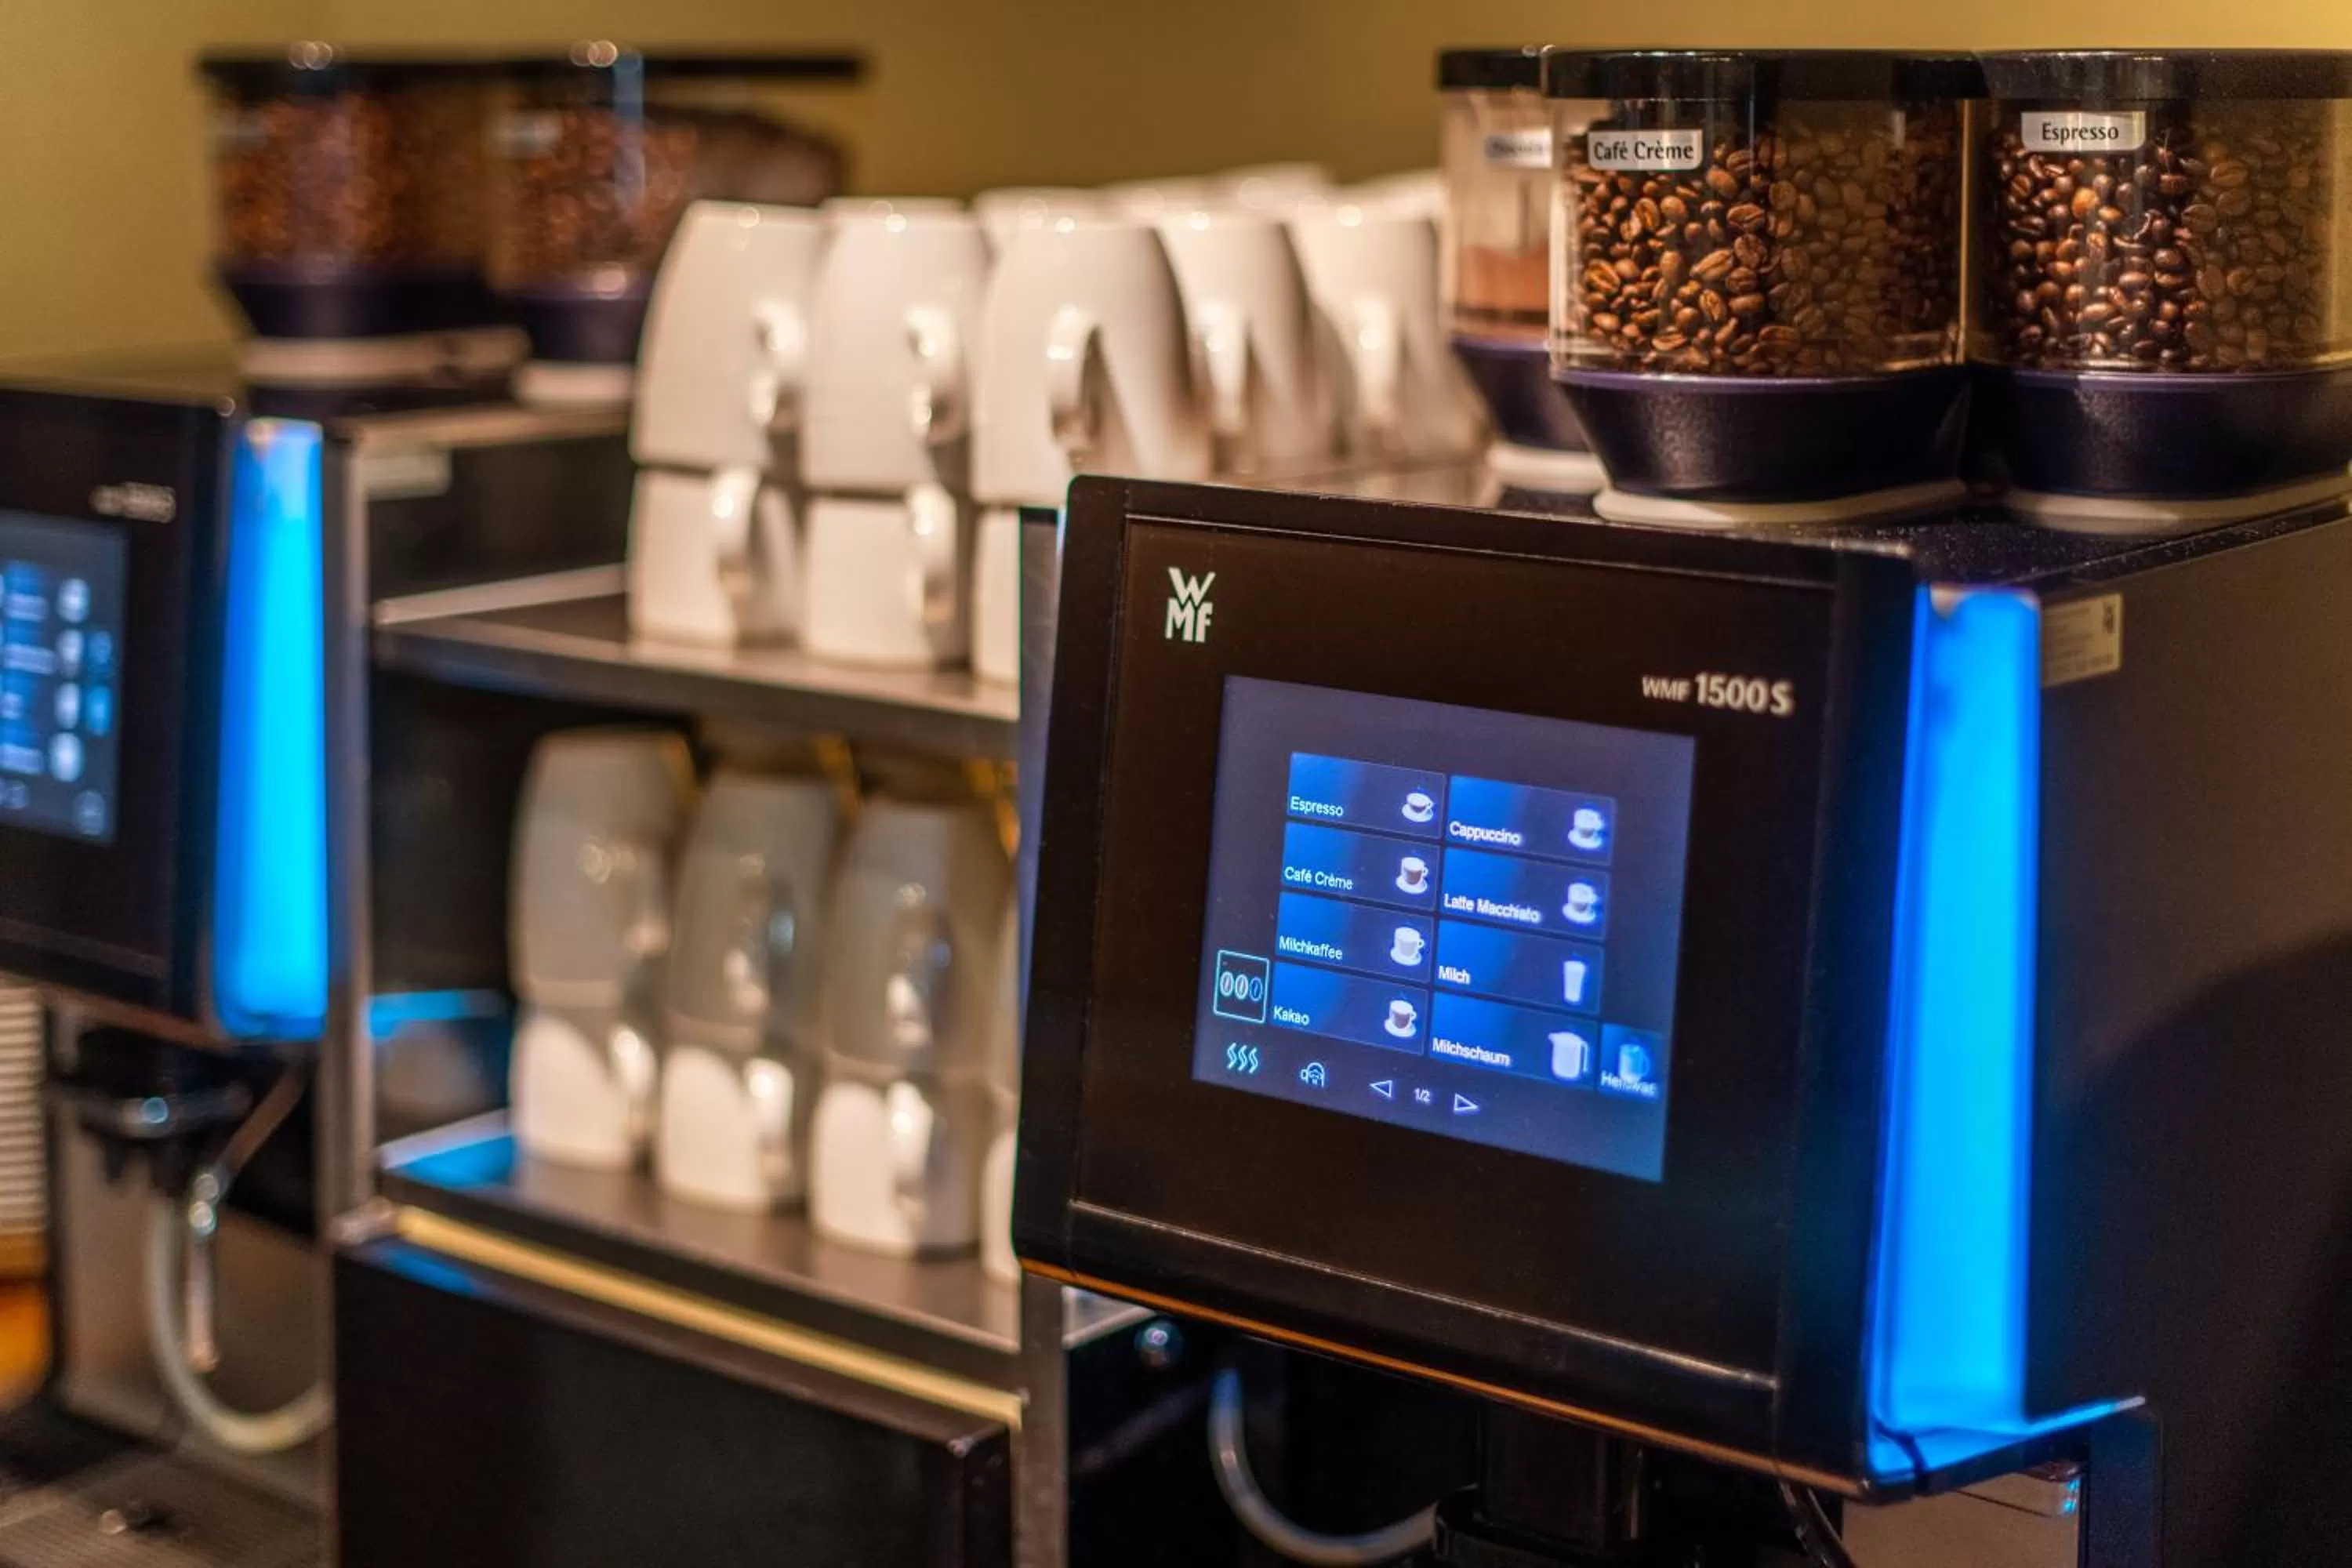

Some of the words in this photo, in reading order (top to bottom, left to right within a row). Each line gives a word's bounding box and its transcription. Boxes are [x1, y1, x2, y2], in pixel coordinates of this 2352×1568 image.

[2042, 122, 2120, 145] Espresso
[1593, 140, 1628, 161] Café
[1634, 140, 1694, 160] Crème
[1642, 675, 1690, 702] WMF
[1290, 796, 1344, 817] Espresso
[1450, 821, 1522, 845] Cappuccino
[1284, 866, 1312, 883] Café
[1315, 871, 1354, 891] Crème
[1444, 893, 1475, 912] Latte
[1476, 898, 1541, 923] Macchiato
[1279, 935, 1343, 960] Milchkaffee
[1439, 965, 1471, 985] Milch
[1273, 1006, 1310, 1025] Kakao
[1432, 1037, 1511, 1066] Milchschaum
[1414, 1087, 1431, 1103] 1/2
